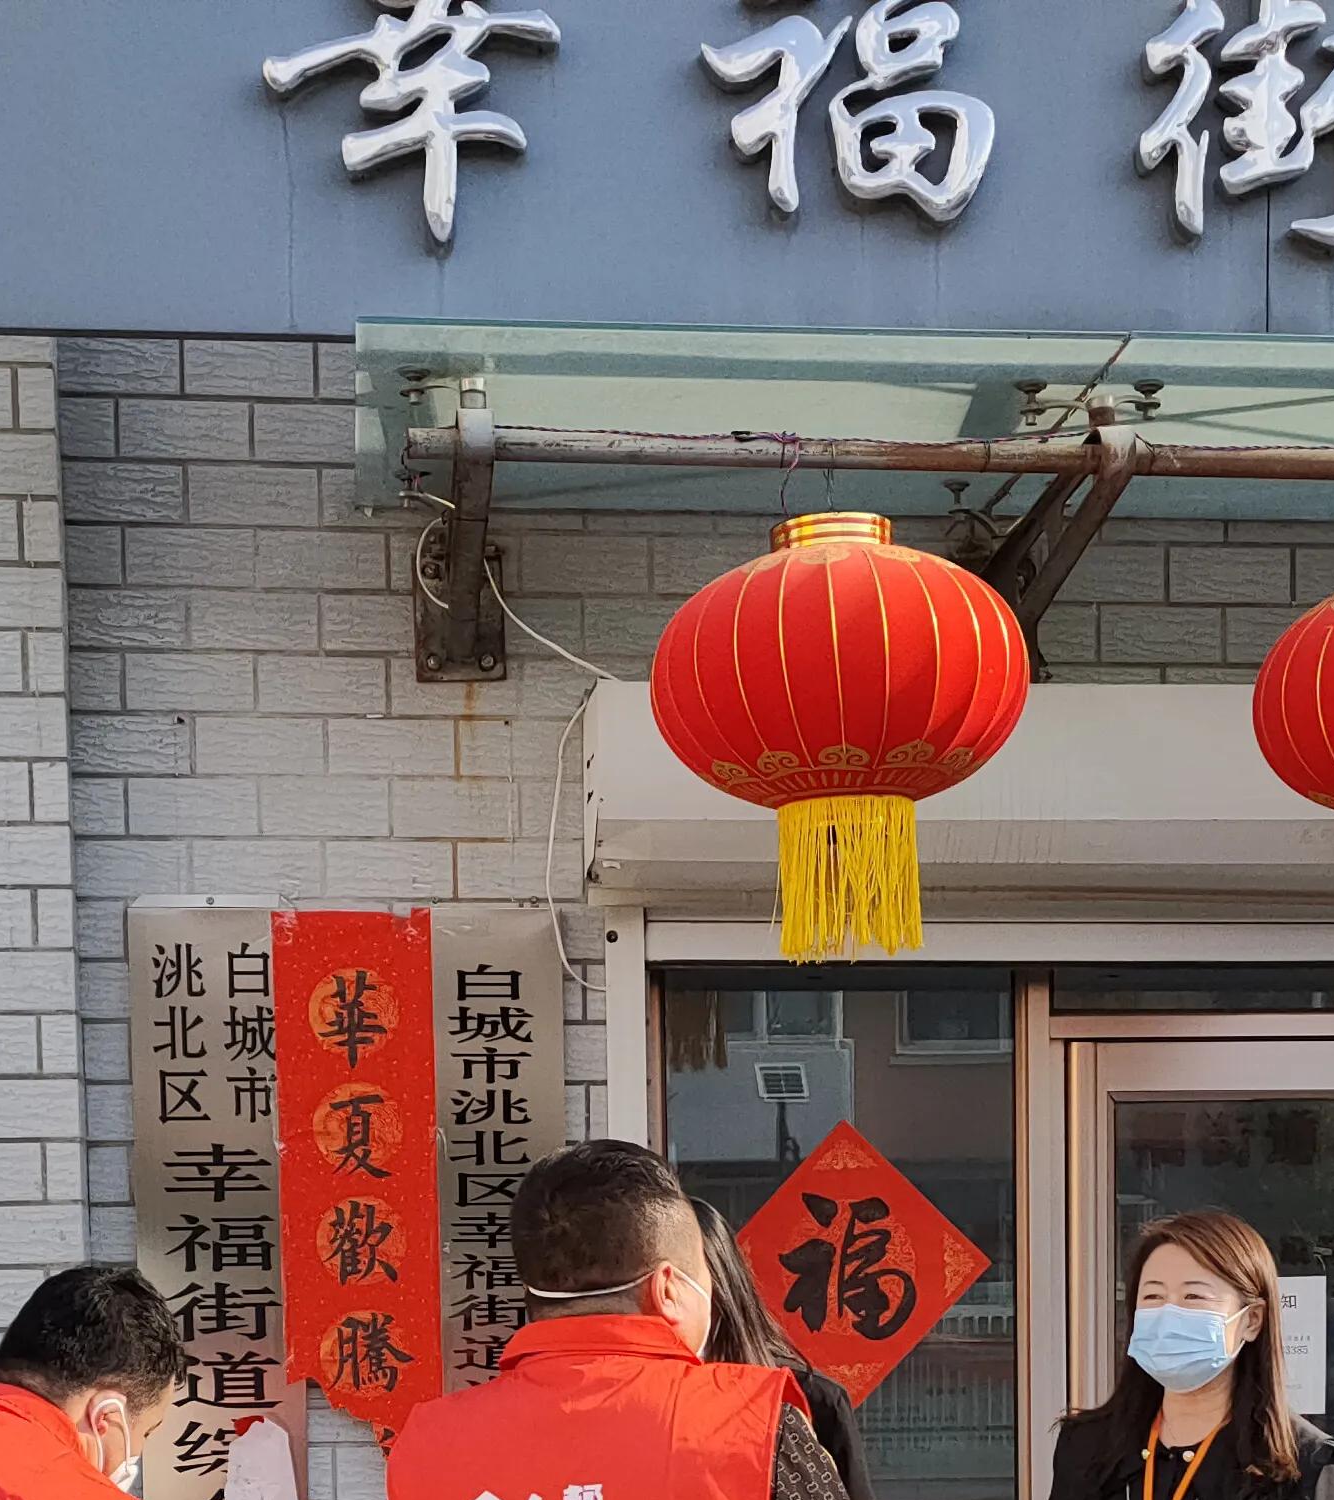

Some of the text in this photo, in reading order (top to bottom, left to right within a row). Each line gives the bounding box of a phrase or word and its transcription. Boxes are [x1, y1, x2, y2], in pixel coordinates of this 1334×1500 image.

[151, 942, 212, 1124] 洮北区
[223, 942, 277, 1124] 白城市
[447, 964, 534, 1388] 白城市洮北区幸福街道
[779, 1193, 916, 1340] 福
[1281, 1293, 1297, 1309] 知
